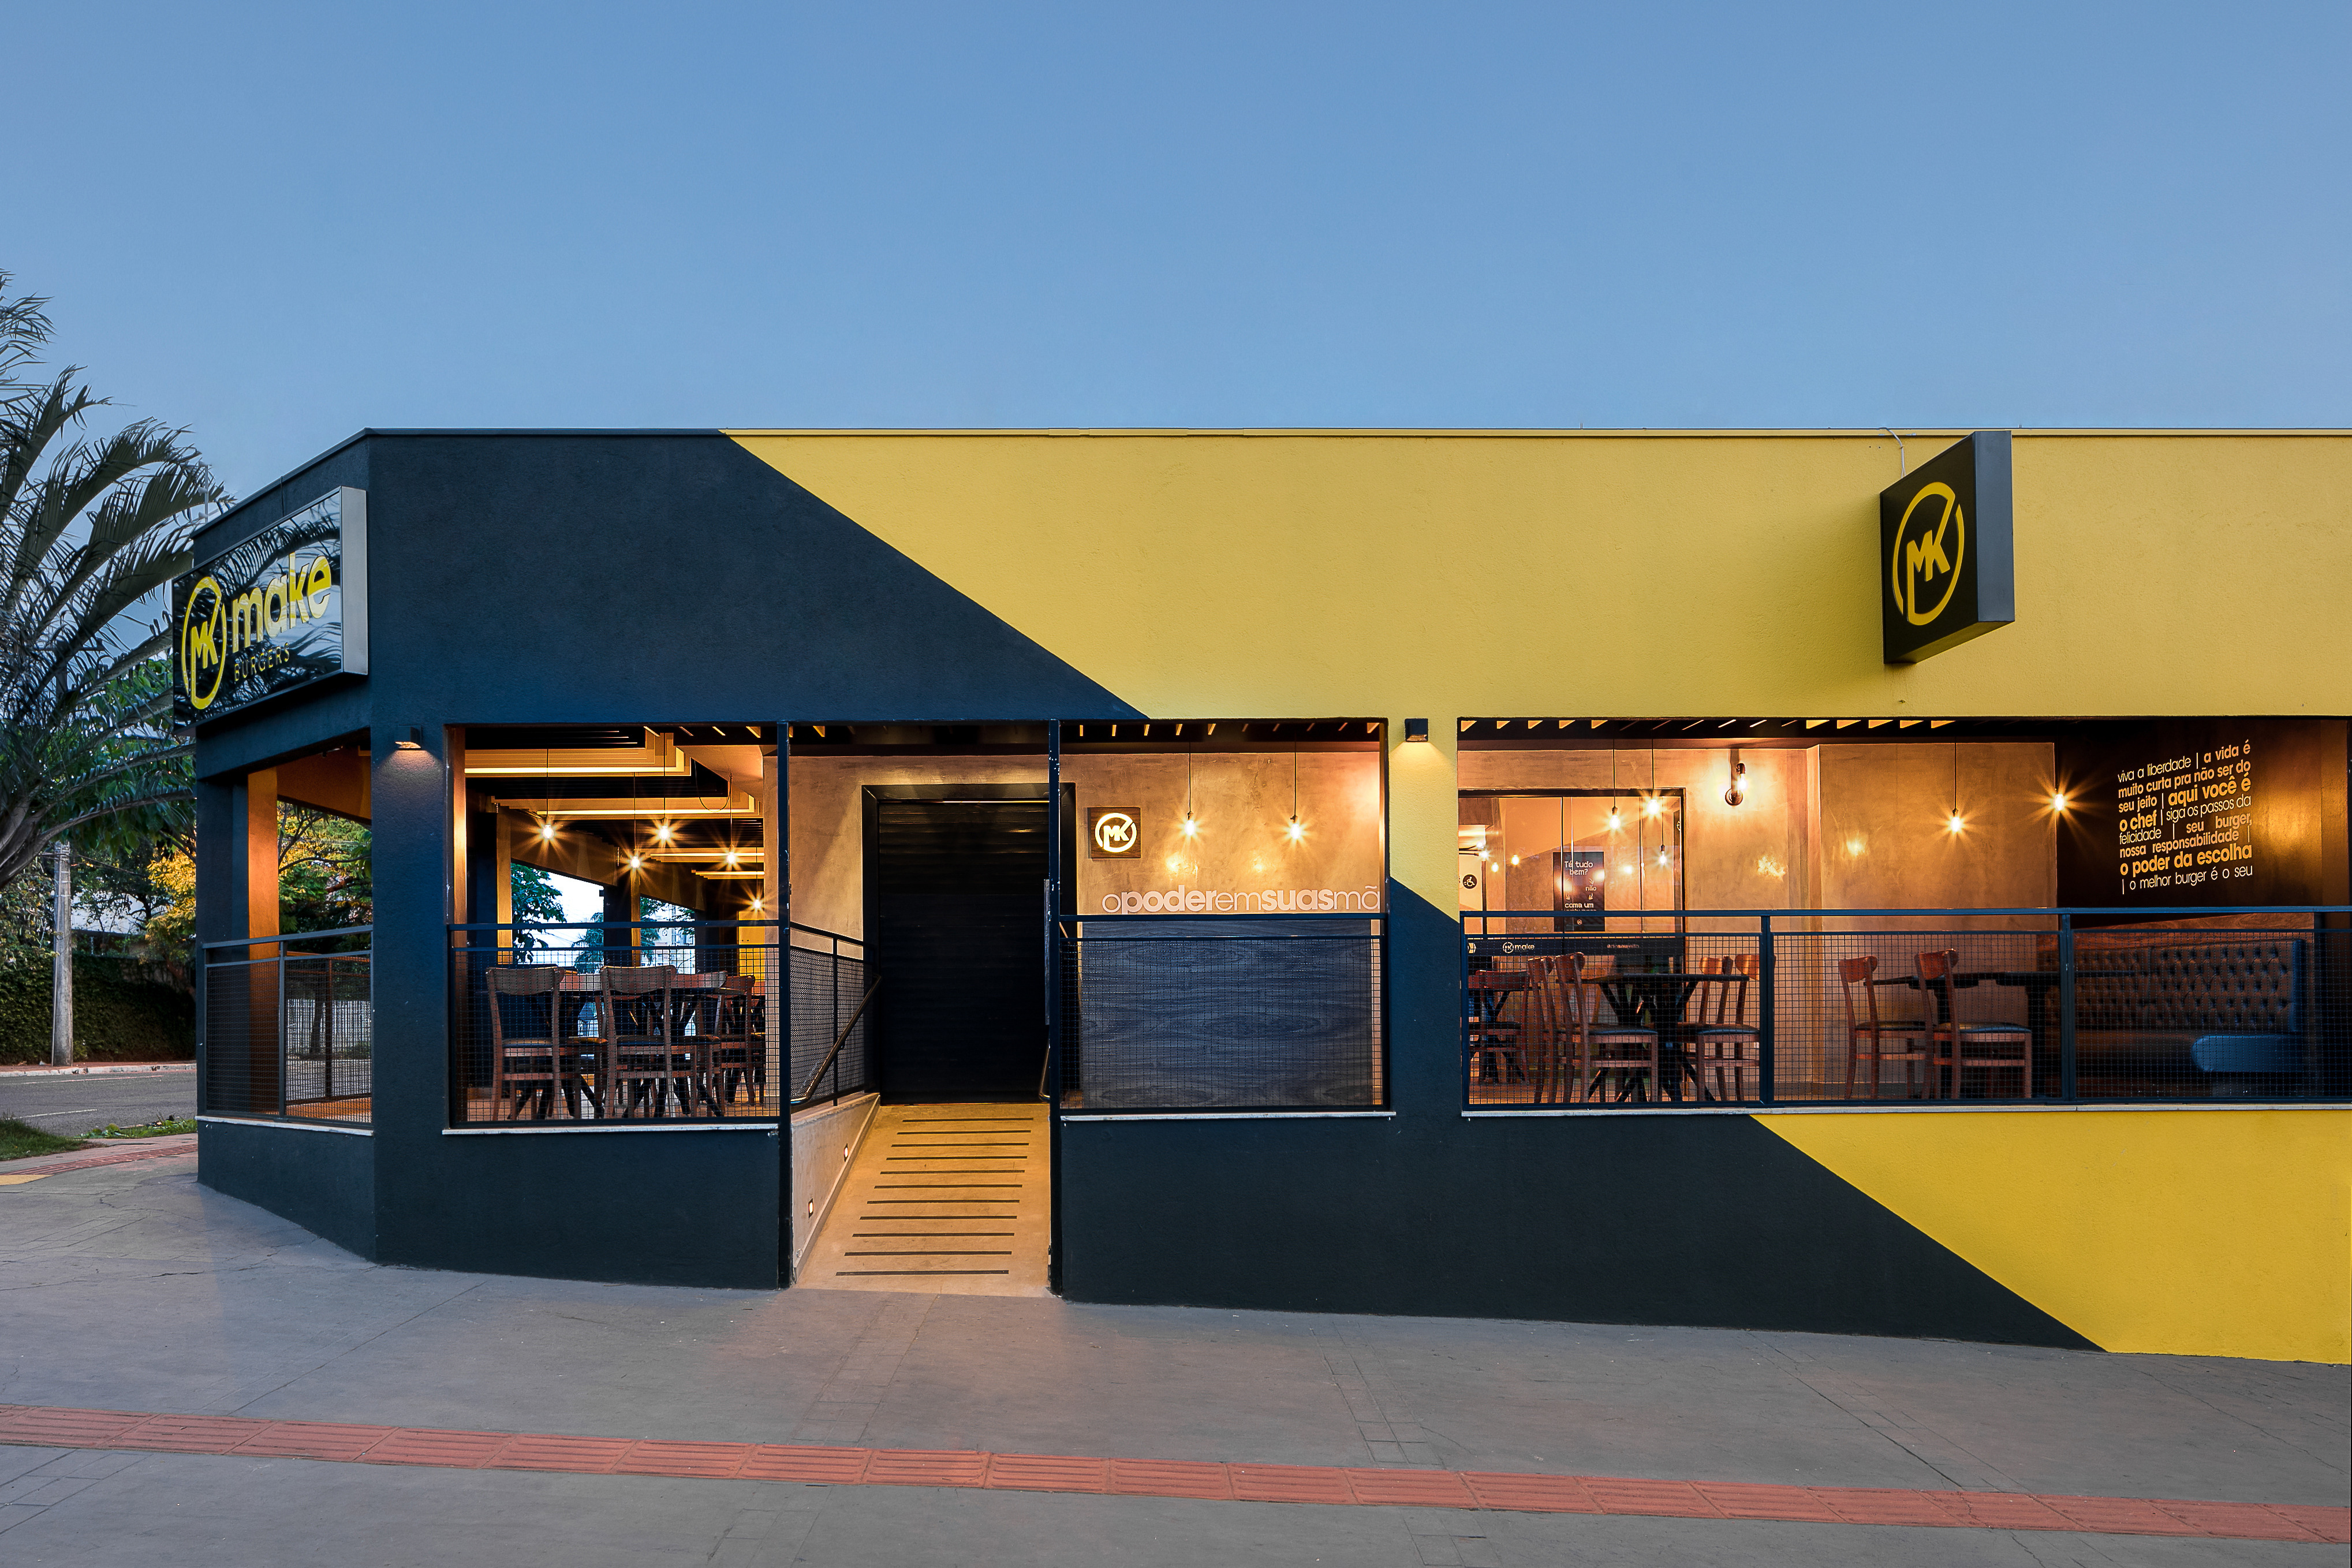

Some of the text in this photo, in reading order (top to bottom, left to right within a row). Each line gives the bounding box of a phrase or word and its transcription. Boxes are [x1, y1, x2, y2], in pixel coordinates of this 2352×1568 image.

[232, 552, 331, 654] make
[234, 642, 290, 681] BURGERS
[2118, 770, 2134, 782] viva
[2138, 768, 2144, 778] a
[2148, 756, 2191, 776] liberdade
[2204, 752, 2211, 763] a
[2215, 744, 2239, 761] vida
[2243, 739, 2250, 754] é
[2118, 759, 2250, 798] muito curta pra não ser do
[2119, 800, 2134, 812] seu
[2137, 794, 2157, 812] jeito
[2168, 785, 2197, 807] aqui
[2202, 777, 2237, 799] você
[2241, 772, 2251, 792] é
[2119, 819, 2127, 831] o
[2130, 809, 2157, 830] chef
[2167, 808, 2185, 823] siga
[2187, 807, 2198, 817] os
[2201, 799, 2234, 817] passos
[2237, 794, 2251, 807] da
[2119, 827, 2161, 845] felicidade
[2186, 820, 2204, 833] seu
[2215, 813, 2252, 828] burger,
[2120, 845, 2146, 858] nossa
[2152, 830, 2239, 853] responsabilidade
[2120, 843, 2252, 877] o poder da escolha
[2130, 881, 2136, 890] o
[2140, 875, 2171, 888] melhor
[2175, 871, 2207, 886] burger
[2211, 867, 2217, 880] é
[2223, 869, 2230, 878] o
[2234, 865, 2253, 878] seu
